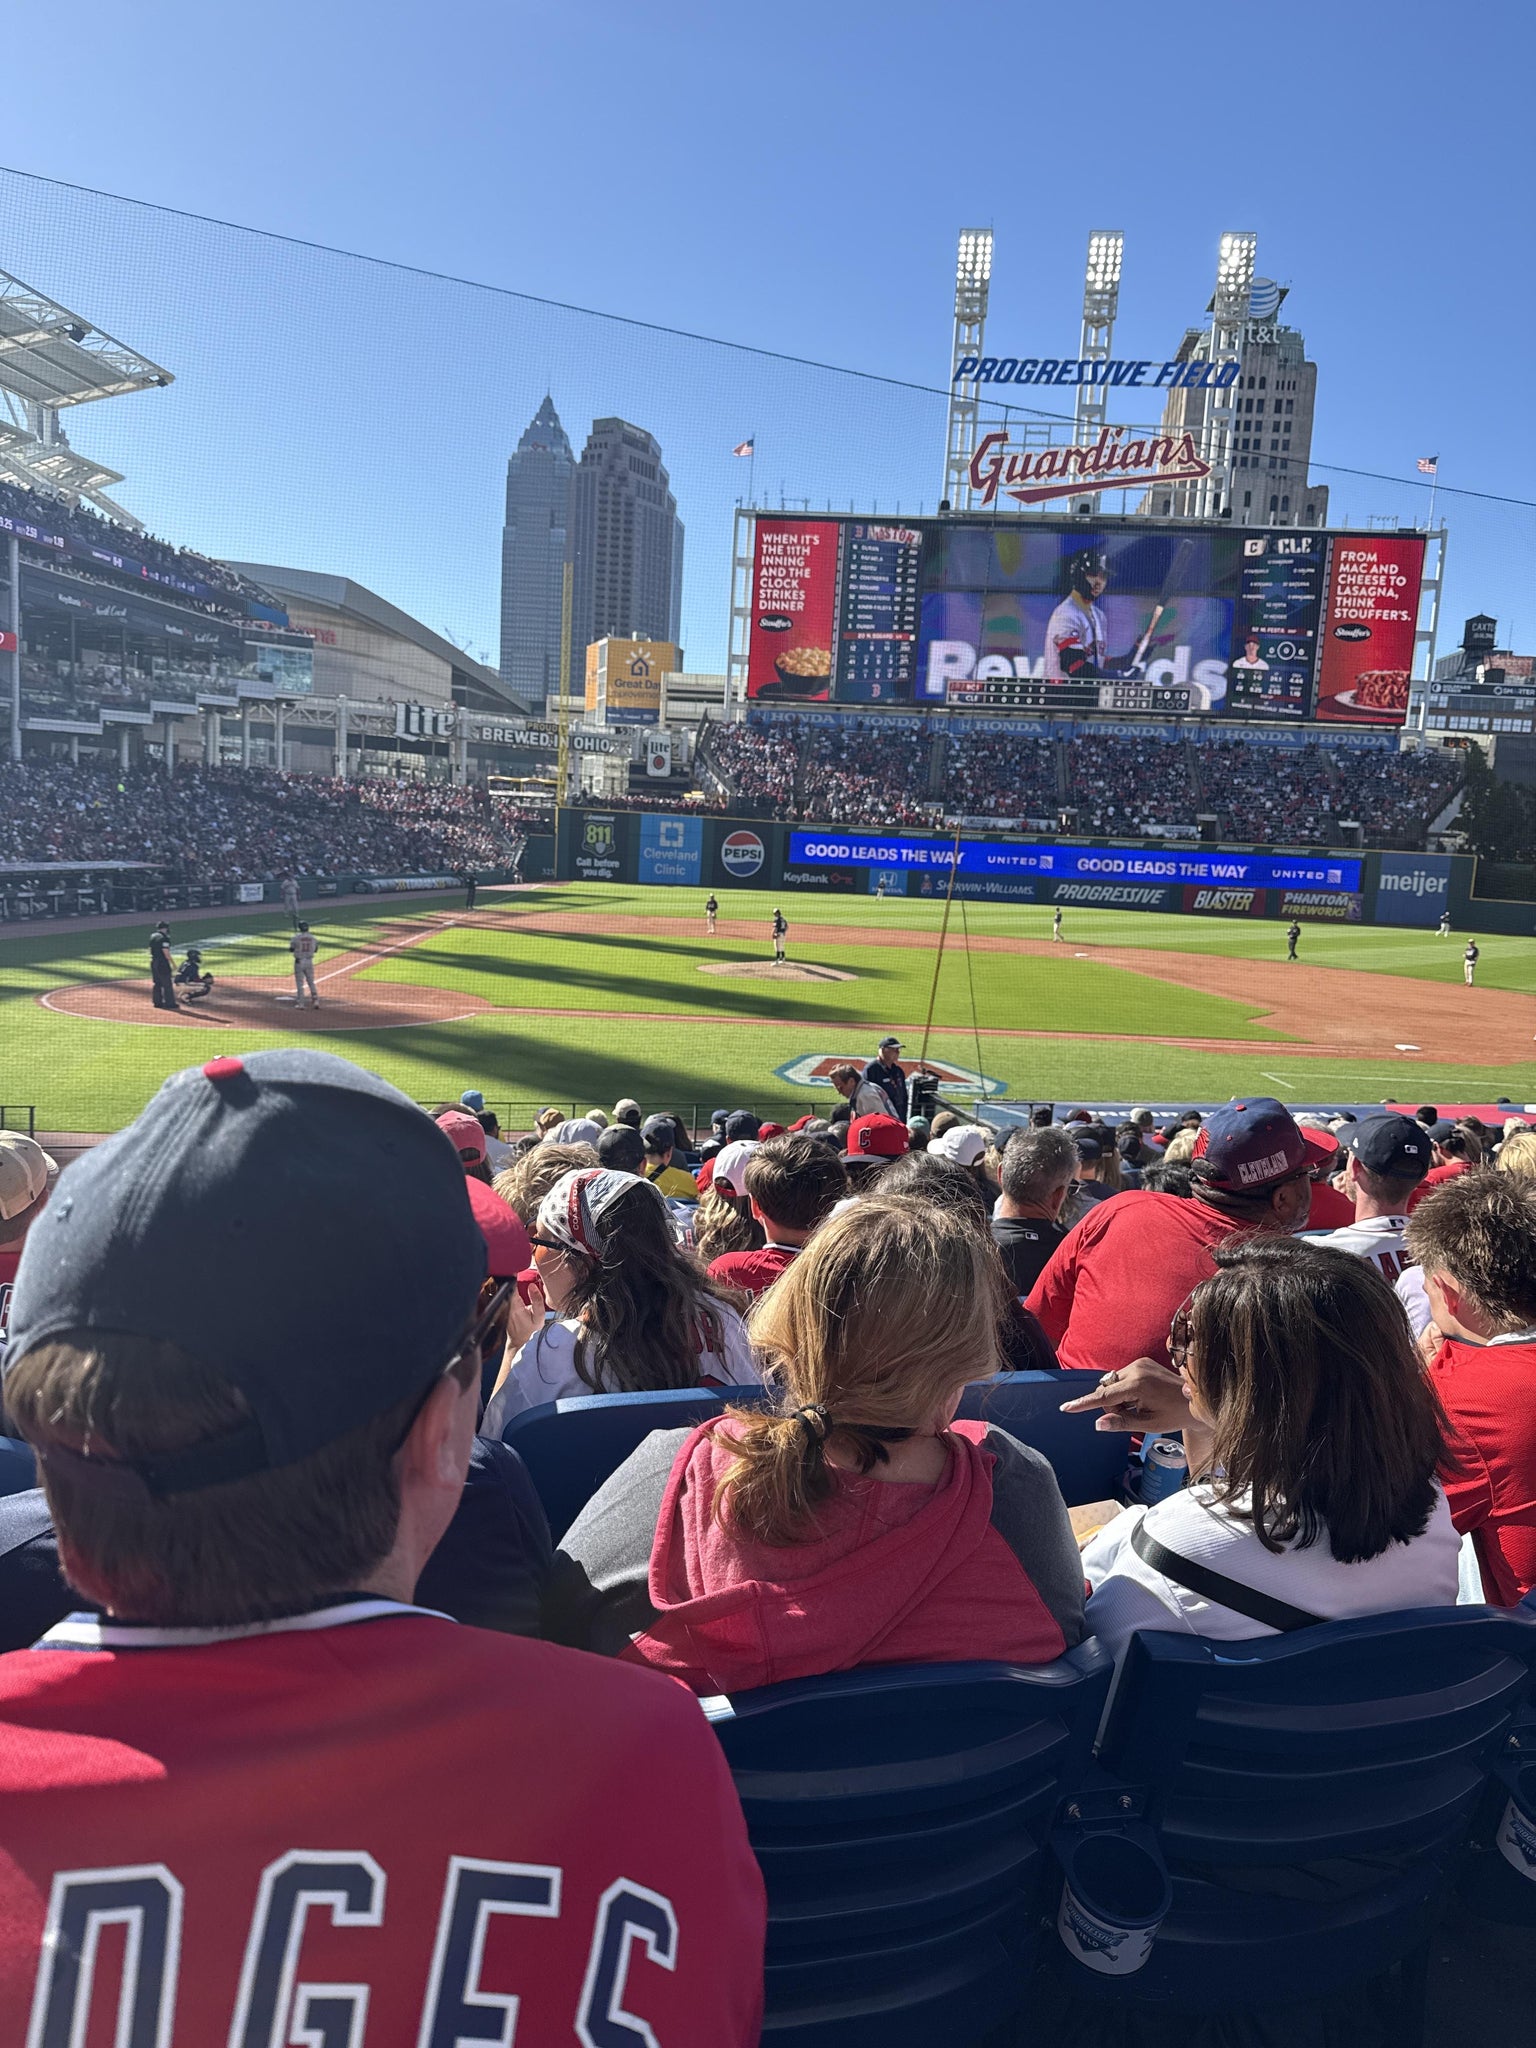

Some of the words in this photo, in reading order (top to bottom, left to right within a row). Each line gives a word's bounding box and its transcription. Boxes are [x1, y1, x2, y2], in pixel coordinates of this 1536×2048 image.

[953, 357, 1151, 386] PROGRESSIVE
[1153, 361, 1242, 388] FIELD
[968, 426, 1212, 506] Guardians
[762, 533, 799, 545] WHEN
[801, 535, 820, 546] IT'S
[1278, 537, 1312, 554] CLE
[762, 544, 784, 555] THE
[786, 545, 811, 556] 11TH
[761, 555, 805, 567] INNING
[1340, 551, 1378, 562] FROM
[760, 566, 787, 577] AND
[789, 567, 811, 578] THE
[1339, 563, 1368, 574] MAC
[1372, 563, 1399, 575] AND
[759, 577, 799, 589] CLOCK
[1337, 574, 1387, 586] CHEESE
[1389, 575, 1407, 587] TO
[759, 588, 806, 600] STRIKES
[1336, 586, 1399, 600] LASAGNA,
[758, 600, 805, 611] DINNER
[1335, 597, 1376, 608] THINK
[1334, 608, 1412, 621] STOUFFER'S.
[1471, 623, 1495, 632] CAXTO
[615, 678, 643, 689] Great
[393, 702, 456, 742] Lite
[527, 722, 558, 732] PROUD
[975, 720, 1042, 732] HONDA
[1100, 725, 1168, 737] HONDA
[1224, 730, 1296, 742] HONDA
[482, 727, 548, 746] BREWED
[573, 736, 610, 752] OHIO
[1319, 734, 1390, 746] HONDA
[586, 825, 611, 845] 811
[643, 847, 698, 862] Cleveland
[724, 848, 761, 860] PEPSI
[576, 857, 592, 866] Call
[594, 858, 620, 868] before
[805, 843, 850, 858] GOOD
[852, 846, 898, 861] LEADS
[901, 849, 928, 863] THE
[930, 851, 966, 865] WAY
[987, 856, 1037, 866] UNITED
[1077, 858, 1125, 873] GOOD
[1127, 860, 1176, 876] LEADS
[1179, 863, 1208, 877] THE
[1211, 865, 1248, 879] WAY
[1272, 869, 1324, 880] UNITED
[582, 868, 597, 877] you
[598, 868, 613, 878] dig.
[654, 863, 686, 876] Clinic
[783, 872, 828, 884] KeyBank
[1380, 870, 1448, 896] meijer
[1054, 884, 1166, 904] PROGRESSIVE
[1284, 892, 1349, 906] PHANTOM
[1193, 890, 1255, 911] BLASTER
[1281, 904, 1346, 917] FIREWORKS
[858, 1127, 871, 1148] C
[1237, 1150, 1289, 1184] CLEVELAND
